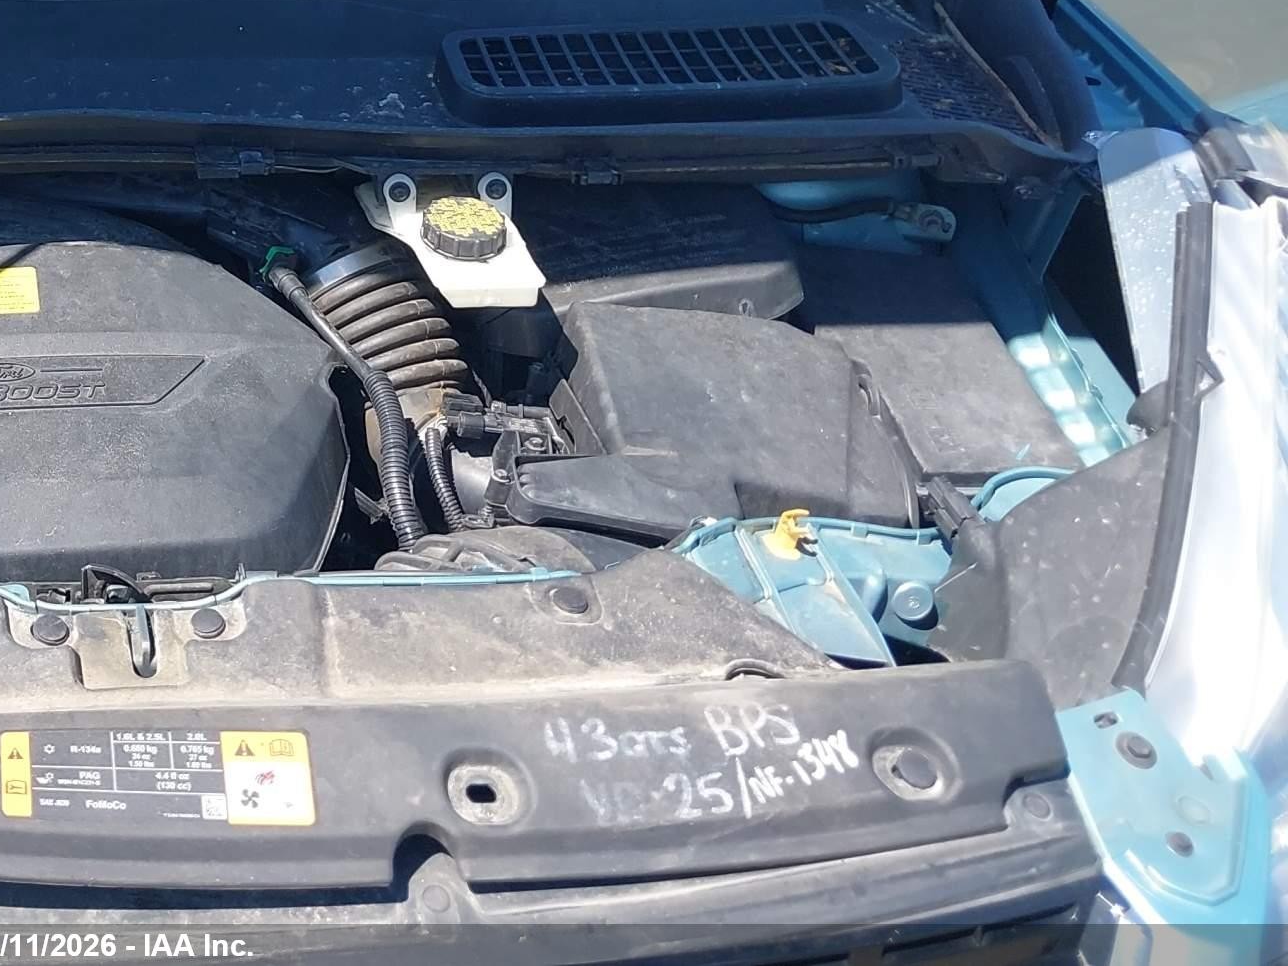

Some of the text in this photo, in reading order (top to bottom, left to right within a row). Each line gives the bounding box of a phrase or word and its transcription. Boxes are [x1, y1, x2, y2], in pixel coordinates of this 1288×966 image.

[703, 703, 800, 756] BPS
[146, 744, 158, 754] kg
[79, 771, 101, 780] PAG
[85, 799, 127, 810] FoMoCo
